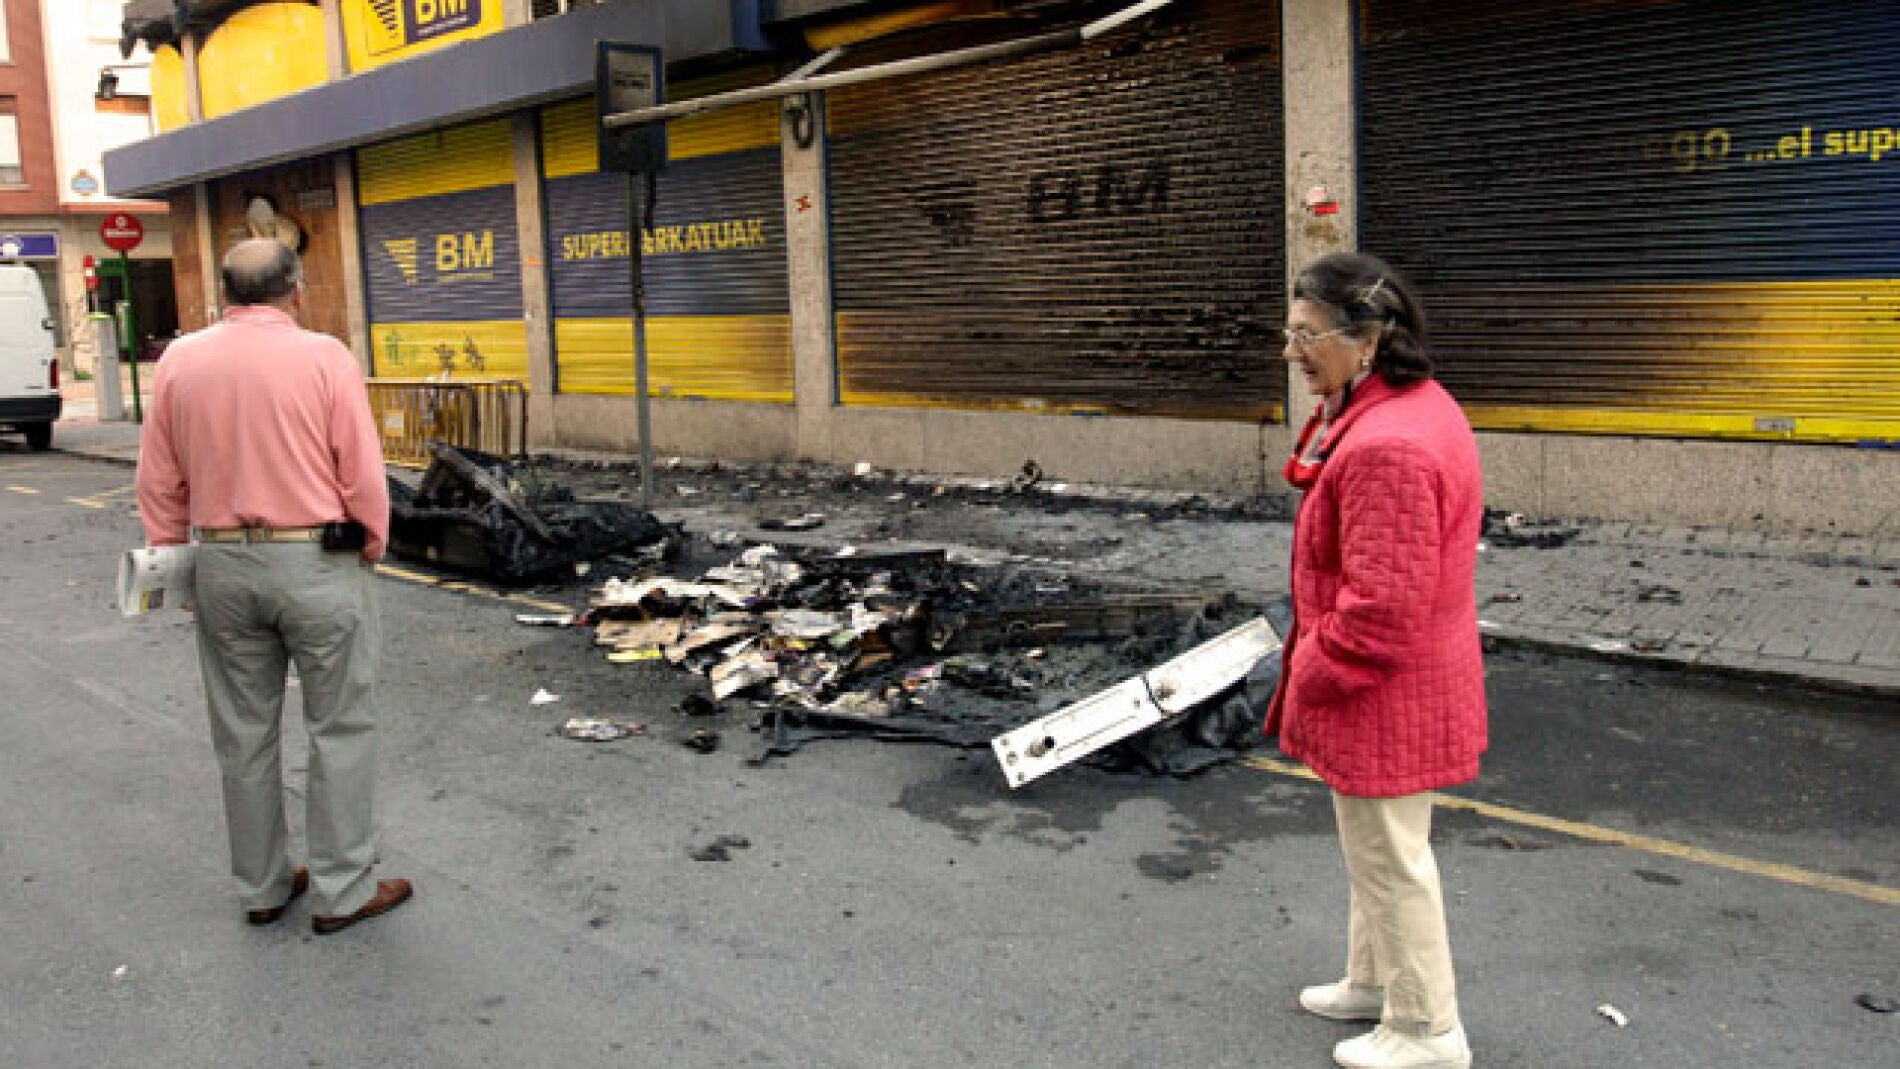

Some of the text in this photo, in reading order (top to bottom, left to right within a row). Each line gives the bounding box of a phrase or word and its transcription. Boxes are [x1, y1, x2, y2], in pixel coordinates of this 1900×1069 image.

[1823, 127, 1900, 161] sup
[1027, 158, 1170, 221] BM
[436, 231, 494, 270] BM
[560, 216, 766, 261] SUPERERKATUAK
